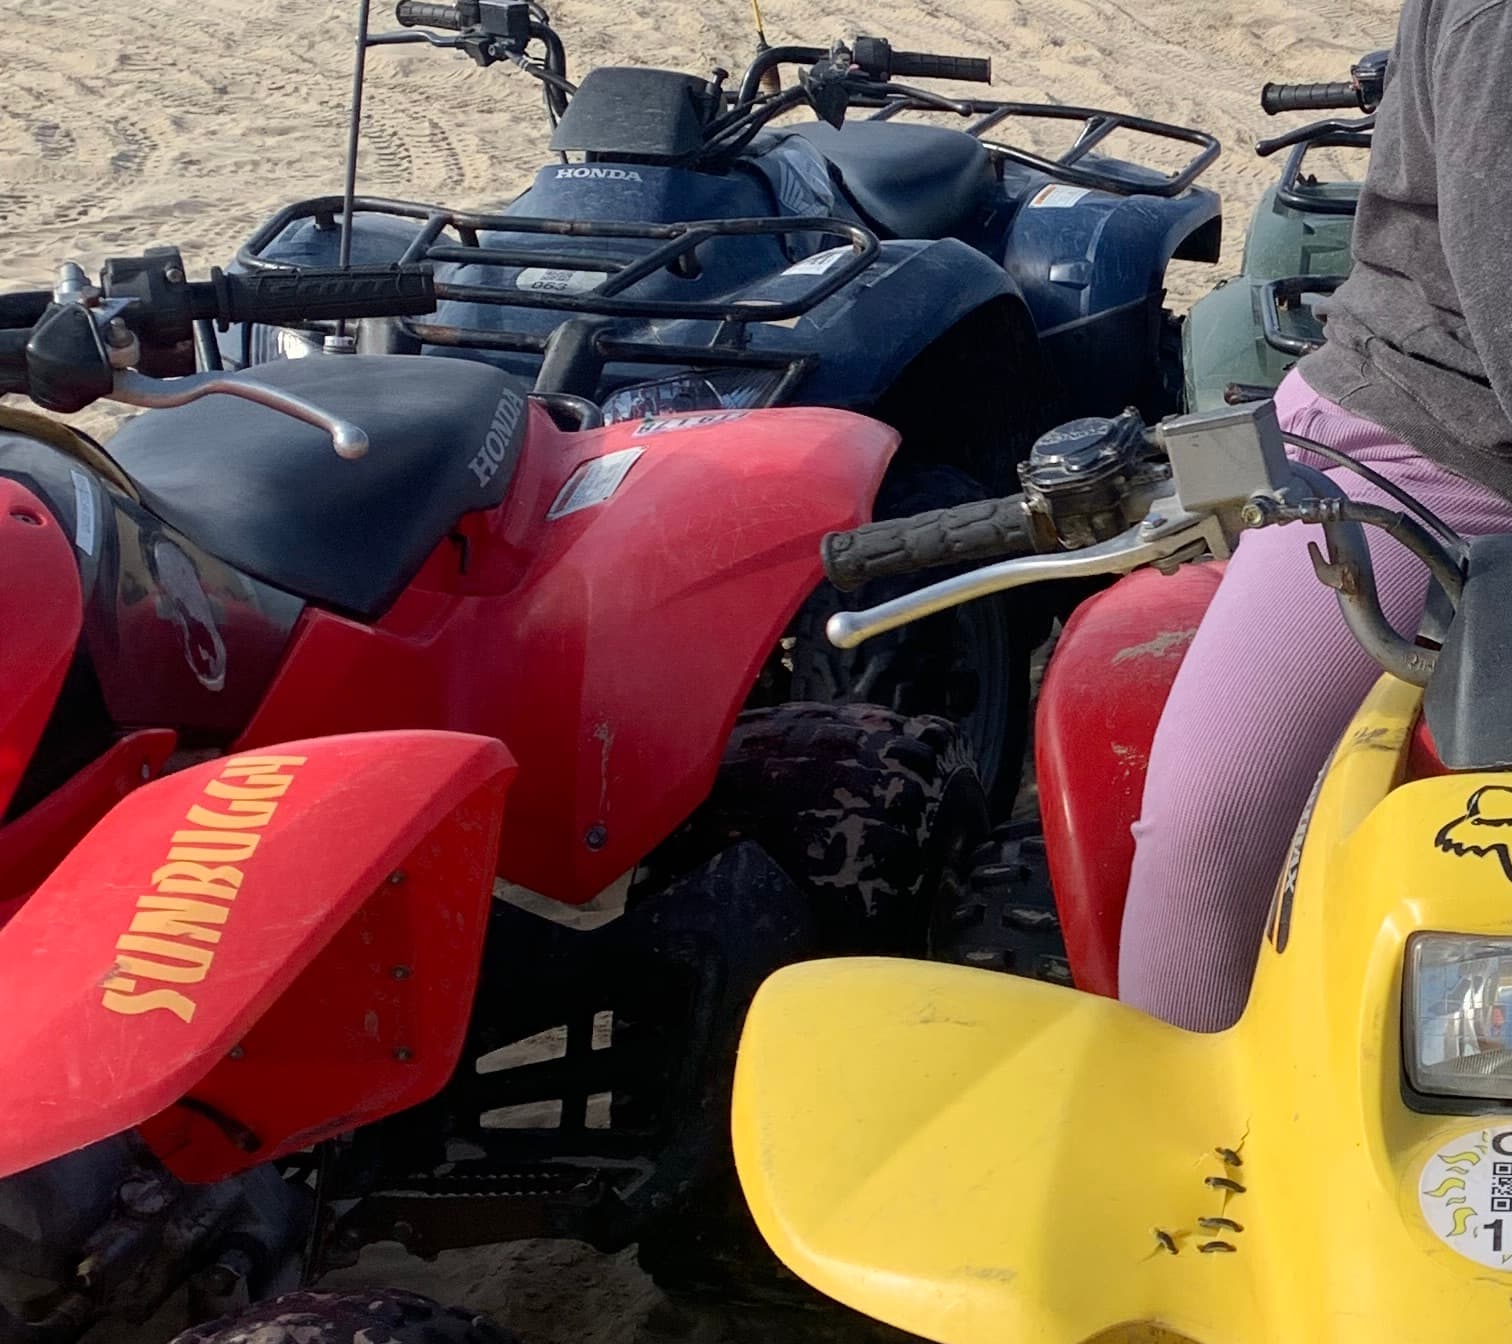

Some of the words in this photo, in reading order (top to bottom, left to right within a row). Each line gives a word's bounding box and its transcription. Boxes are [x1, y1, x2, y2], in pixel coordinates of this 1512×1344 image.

[556, 167, 643, 182] HONDA
[531, 281, 568, 291] 063
[467, 387, 524, 489] HONDA
[101, 755, 308, 1024] SUNBUGGY
